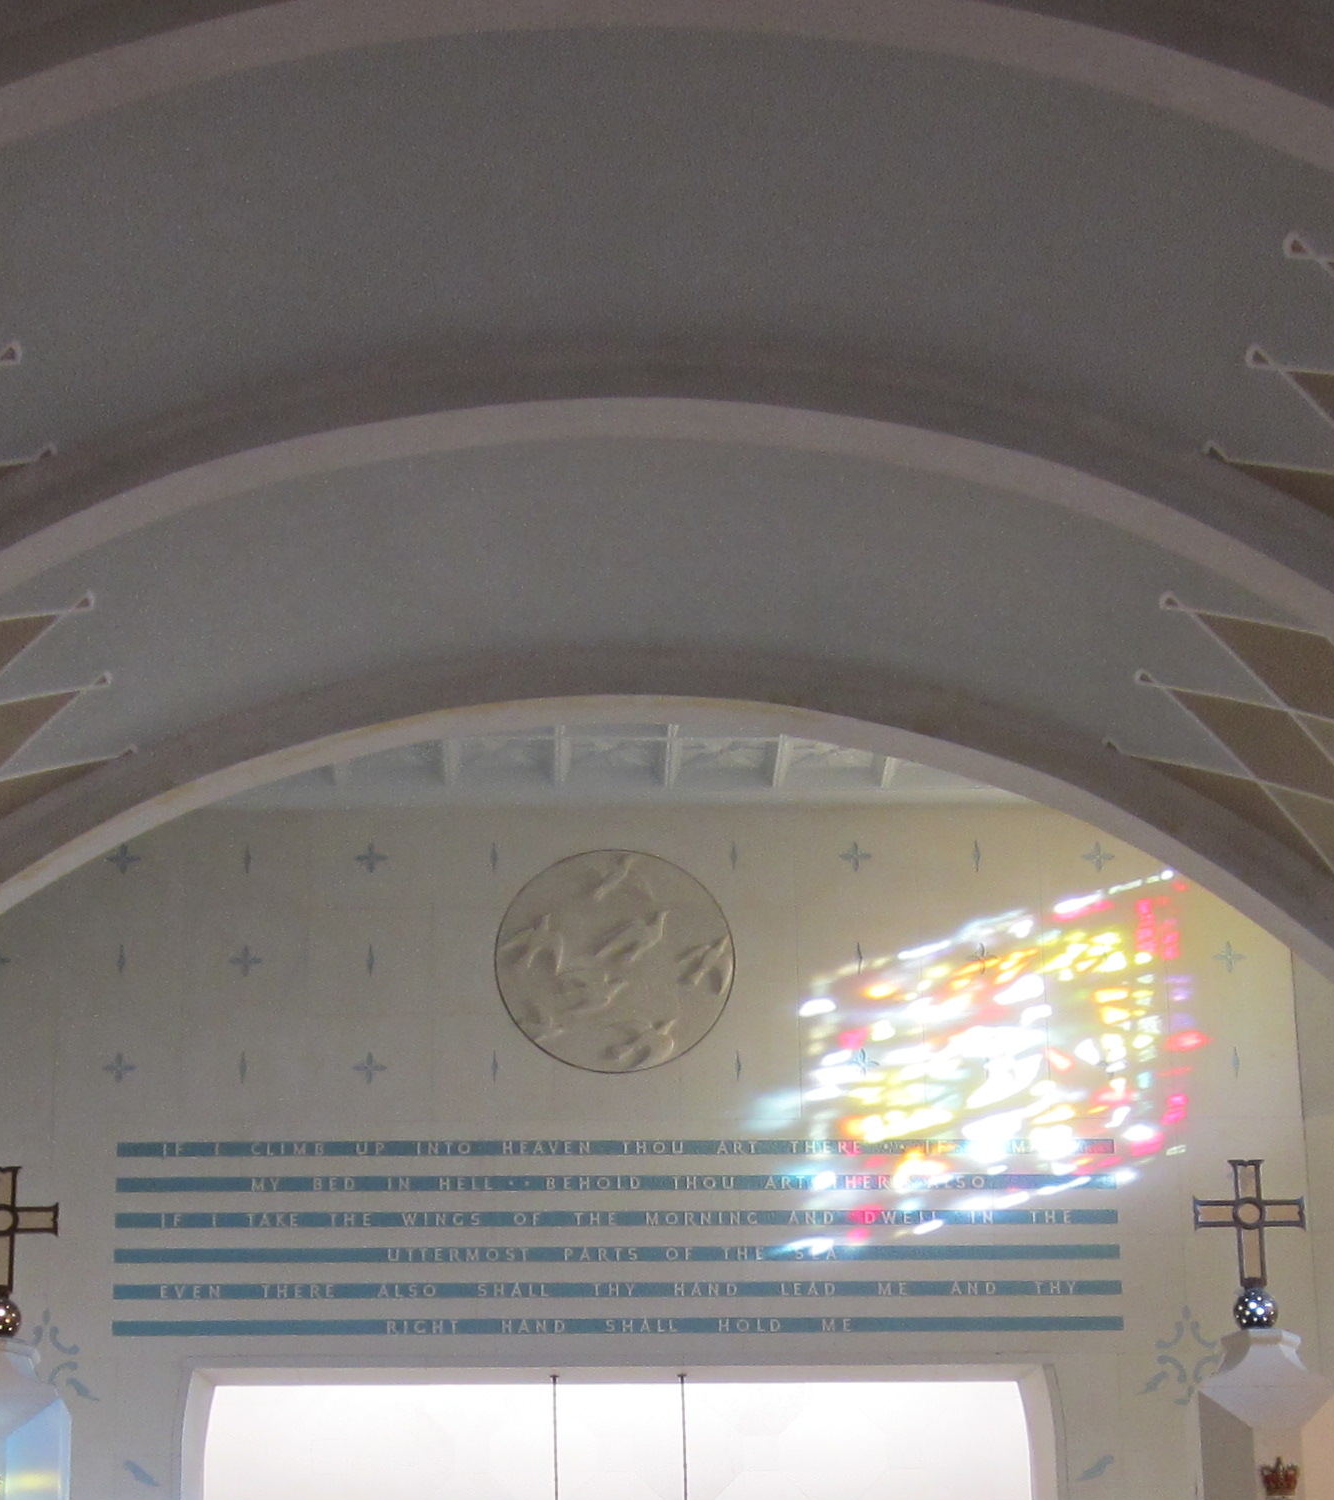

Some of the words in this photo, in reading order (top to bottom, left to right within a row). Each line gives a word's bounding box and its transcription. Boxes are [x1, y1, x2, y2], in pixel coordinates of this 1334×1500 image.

[162, 1143, 184, 1157] IF
[250, 1143, 325, 1156] CLIMB
[355, 1142, 385, 1155] UP
[416, 1142, 472, 1155] INTO
[502, 1141, 591, 1155] HEAVEN
[621, 1141, 684, 1154] THOU
[716, 1141, 758, 1154] ART
[789, 1140, 861, 1154] THERE
[251, 1178, 280, 1191] MY
[312, 1178, 356, 1191] BED
[387, 1177, 410, 1190] IN
[439, 1177, 493, 1190] HELL
[546, 1176, 642, 1190] BEHOLD
[672, 1176, 735, 1189] THOU
[764, 1176, 805, 1189] ART
[161, 1213, 182, 1227] IF
[247, 1213, 298, 1227] TAKE
[329, 1213, 372, 1226] THE
[401, 1212, 481, 1226] WINGS
[513, 1212, 541, 1225] OF
[574, 1212, 617, 1225] THE
[645, 1211, 758, 1225] MORNING
[787, 1211, 834, 1225] AND
[970, 1210, 994, 1224] IN
[1029, 1210, 1072, 1223] THE
[387, 1248, 530, 1262] UTTERMOST
[563, 1247, 639, 1261] PARTS
[666, 1247, 693, 1261] OF
[722, 1247, 764, 1260] THE
[159, 1285, 221, 1299] EVEN
[261, 1285, 335, 1299] THERE
[377, 1284, 436, 1298] ALSO
[477, 1283, 549, 1297] SHALL
[593, 1283, 635, 1297] THY
[674, 1283, 738, 1296] HAND
[780, 1282, 836, 1296] LEAD
[877, 1282, 908, 1295] ME
[950, 1281, 997, 1295] AND
[1035, 1281, 1077, 1294] THY
[386, 1320, 459, 1334] RIGHT
[501, 1320, 566, 1334] HAND
[605, 1318, 678, 1333] SHALL
[718, 1319, 781, 1333] HOLD
[821, 1318, 852, 1332] ME
